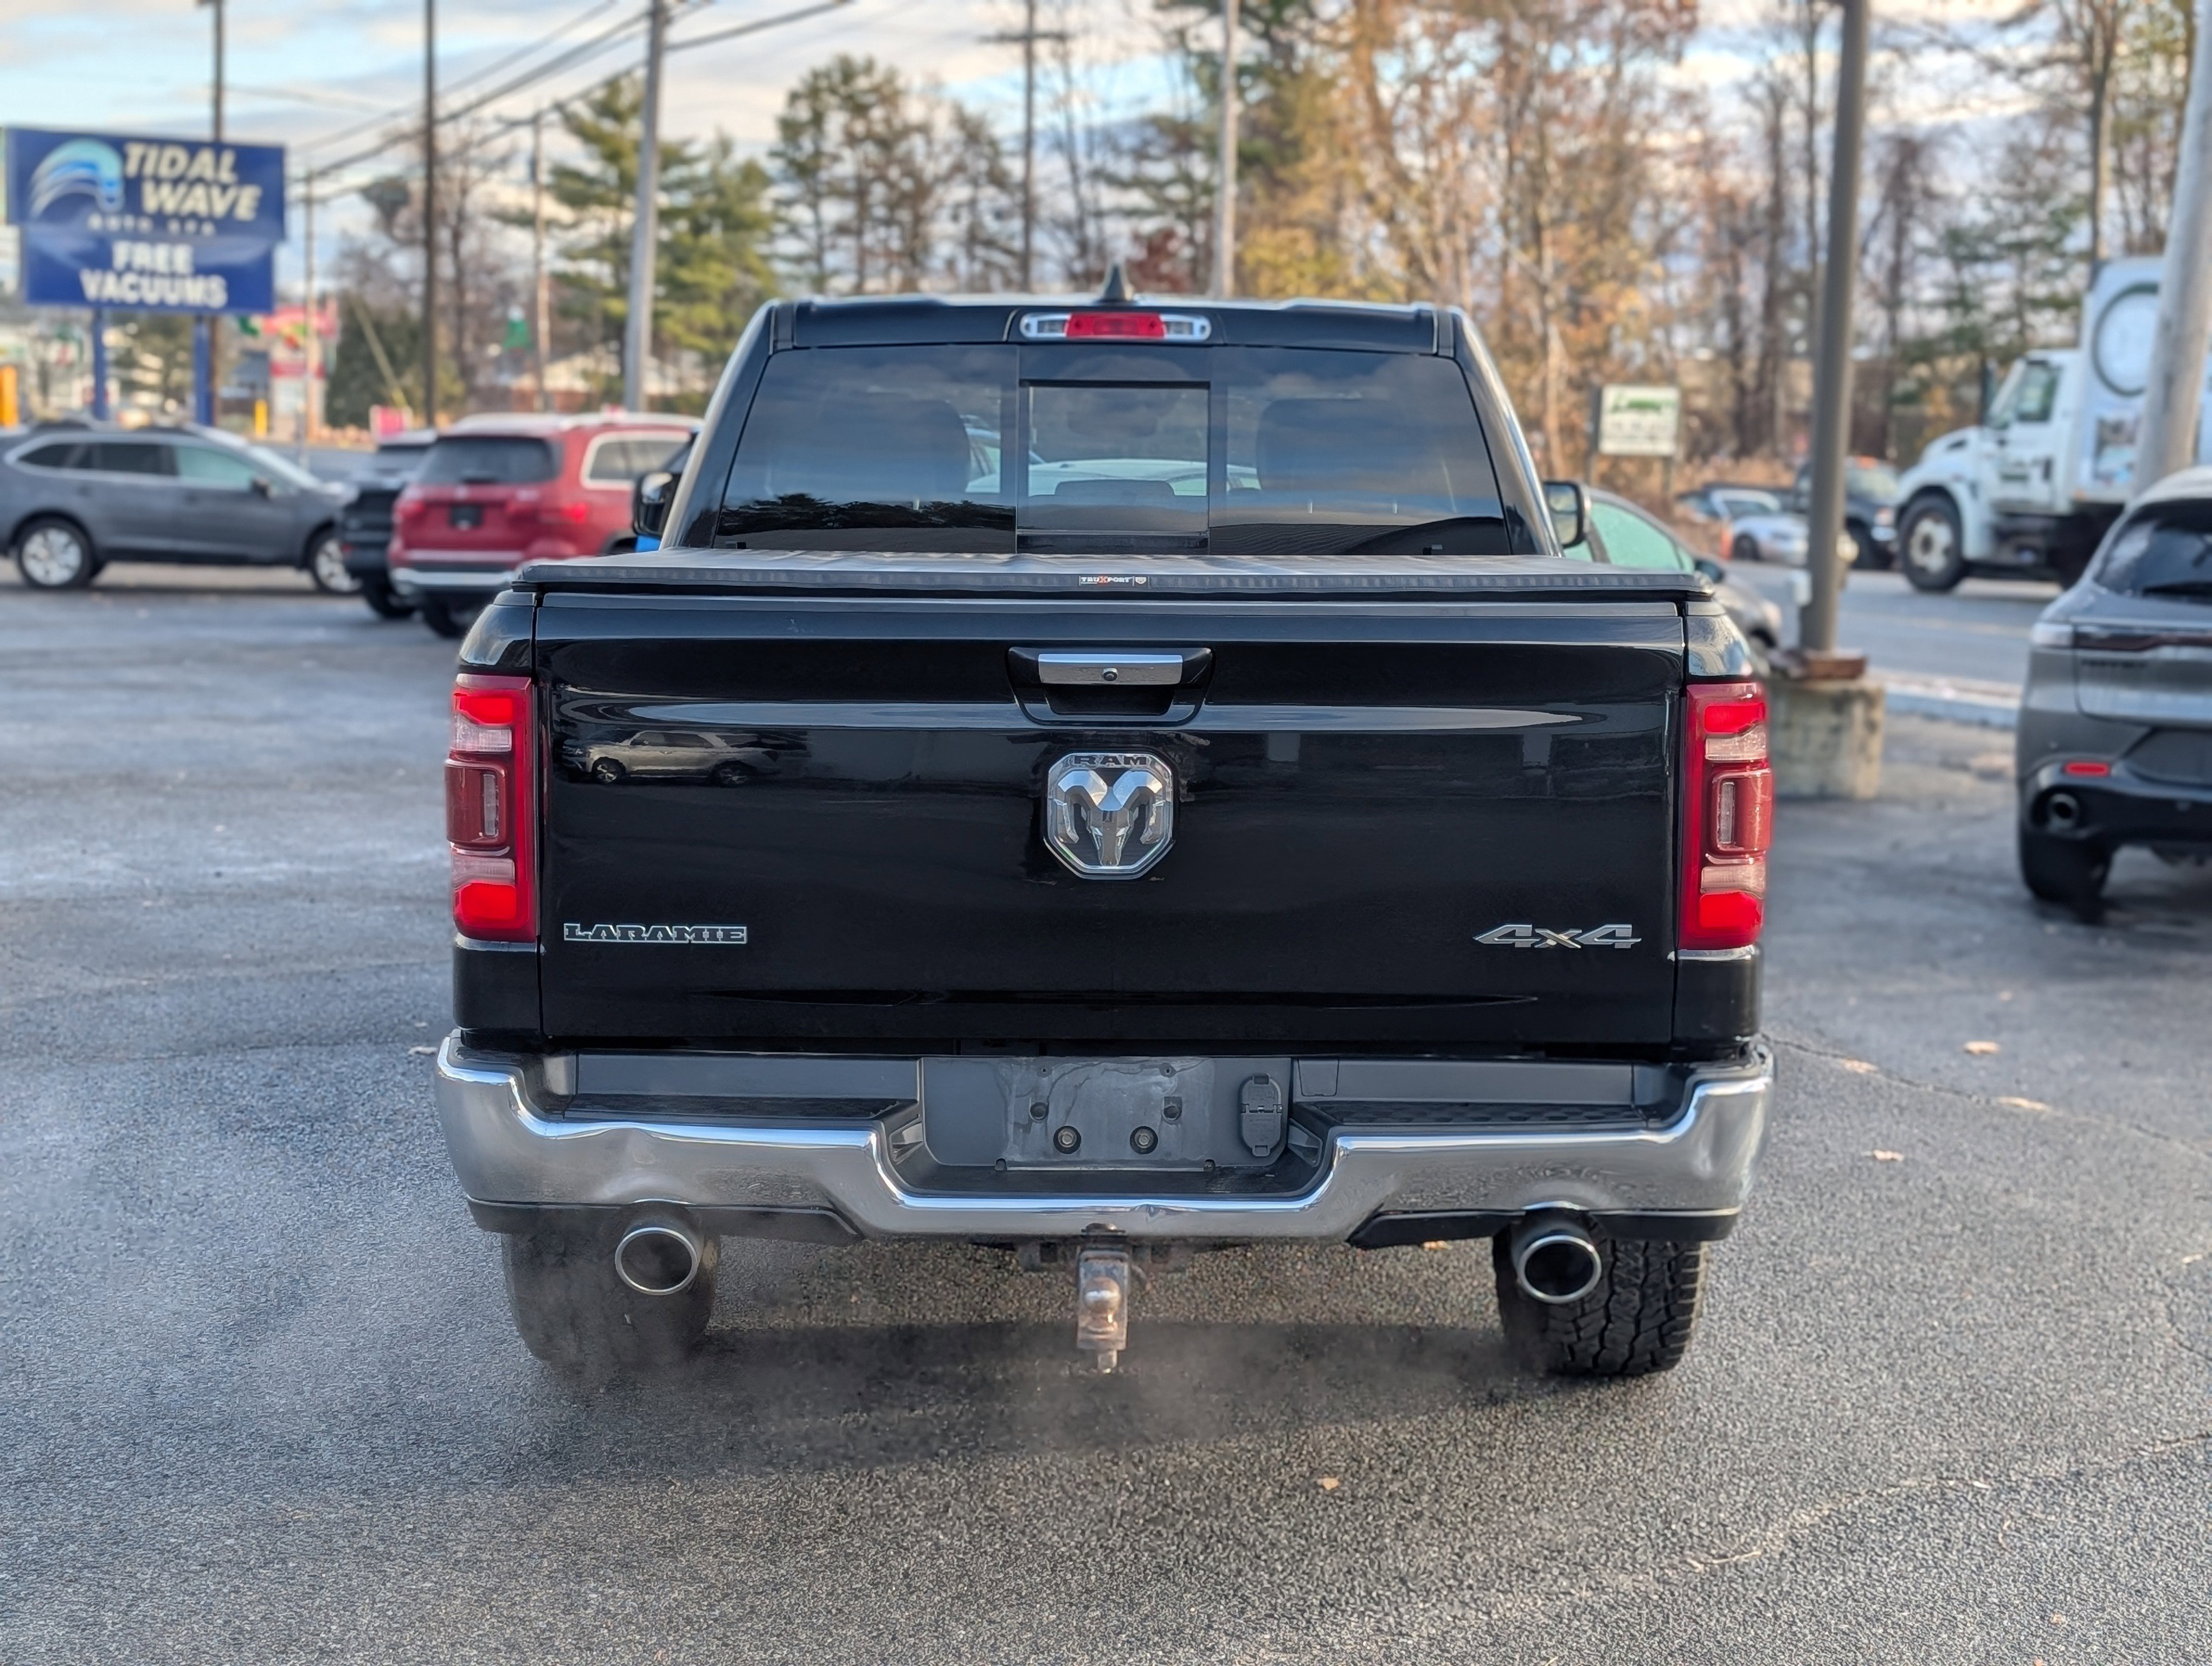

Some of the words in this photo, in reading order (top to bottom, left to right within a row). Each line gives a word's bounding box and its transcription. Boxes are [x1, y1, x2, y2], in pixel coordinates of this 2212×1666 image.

[124, 142, 238, 184] TIDAL
[142, 180, 262, 221] WAVE
[112, 240, 194, 274] FREE
[79, 269, 229, 309] VACUUMS
[1073, 755, 1147, 765] RAM
[564, 923, 747, 944] LARAMIE
